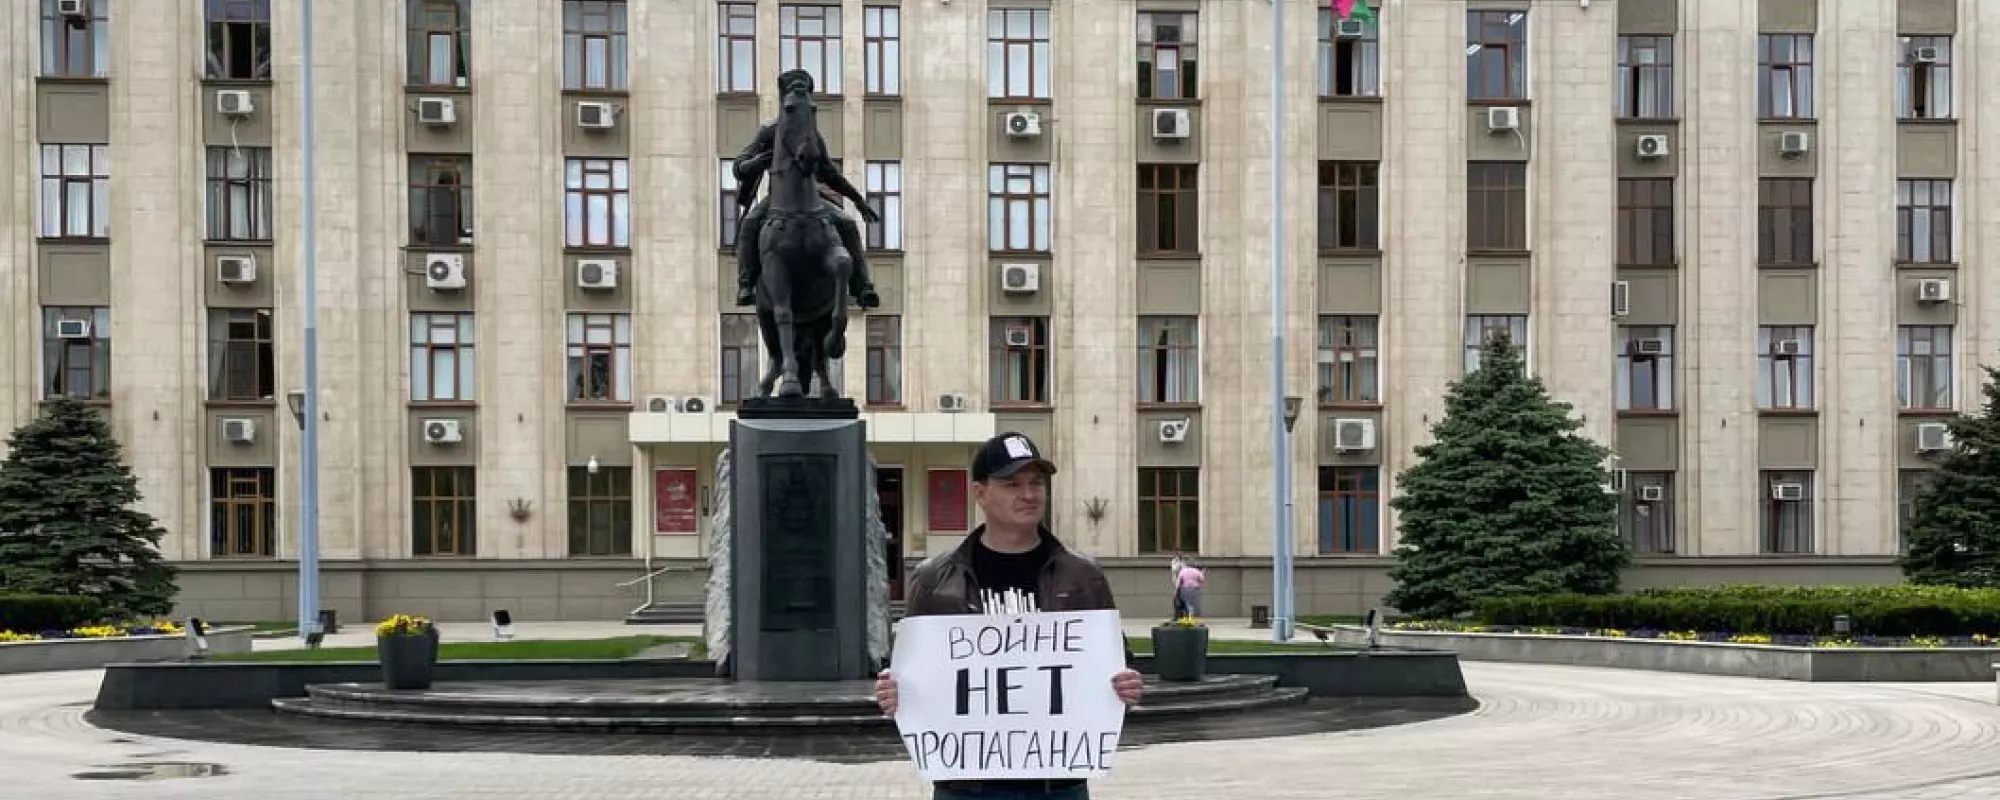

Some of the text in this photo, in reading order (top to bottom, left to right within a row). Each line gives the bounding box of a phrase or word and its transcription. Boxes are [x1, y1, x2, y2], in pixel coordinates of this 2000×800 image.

[950, 618, 1085, 660] ВОЙНЕ
[955, 664, 1073, 716] НЕТ
[902, 729, 1118, 772] ПРОПАГАНДЕ
